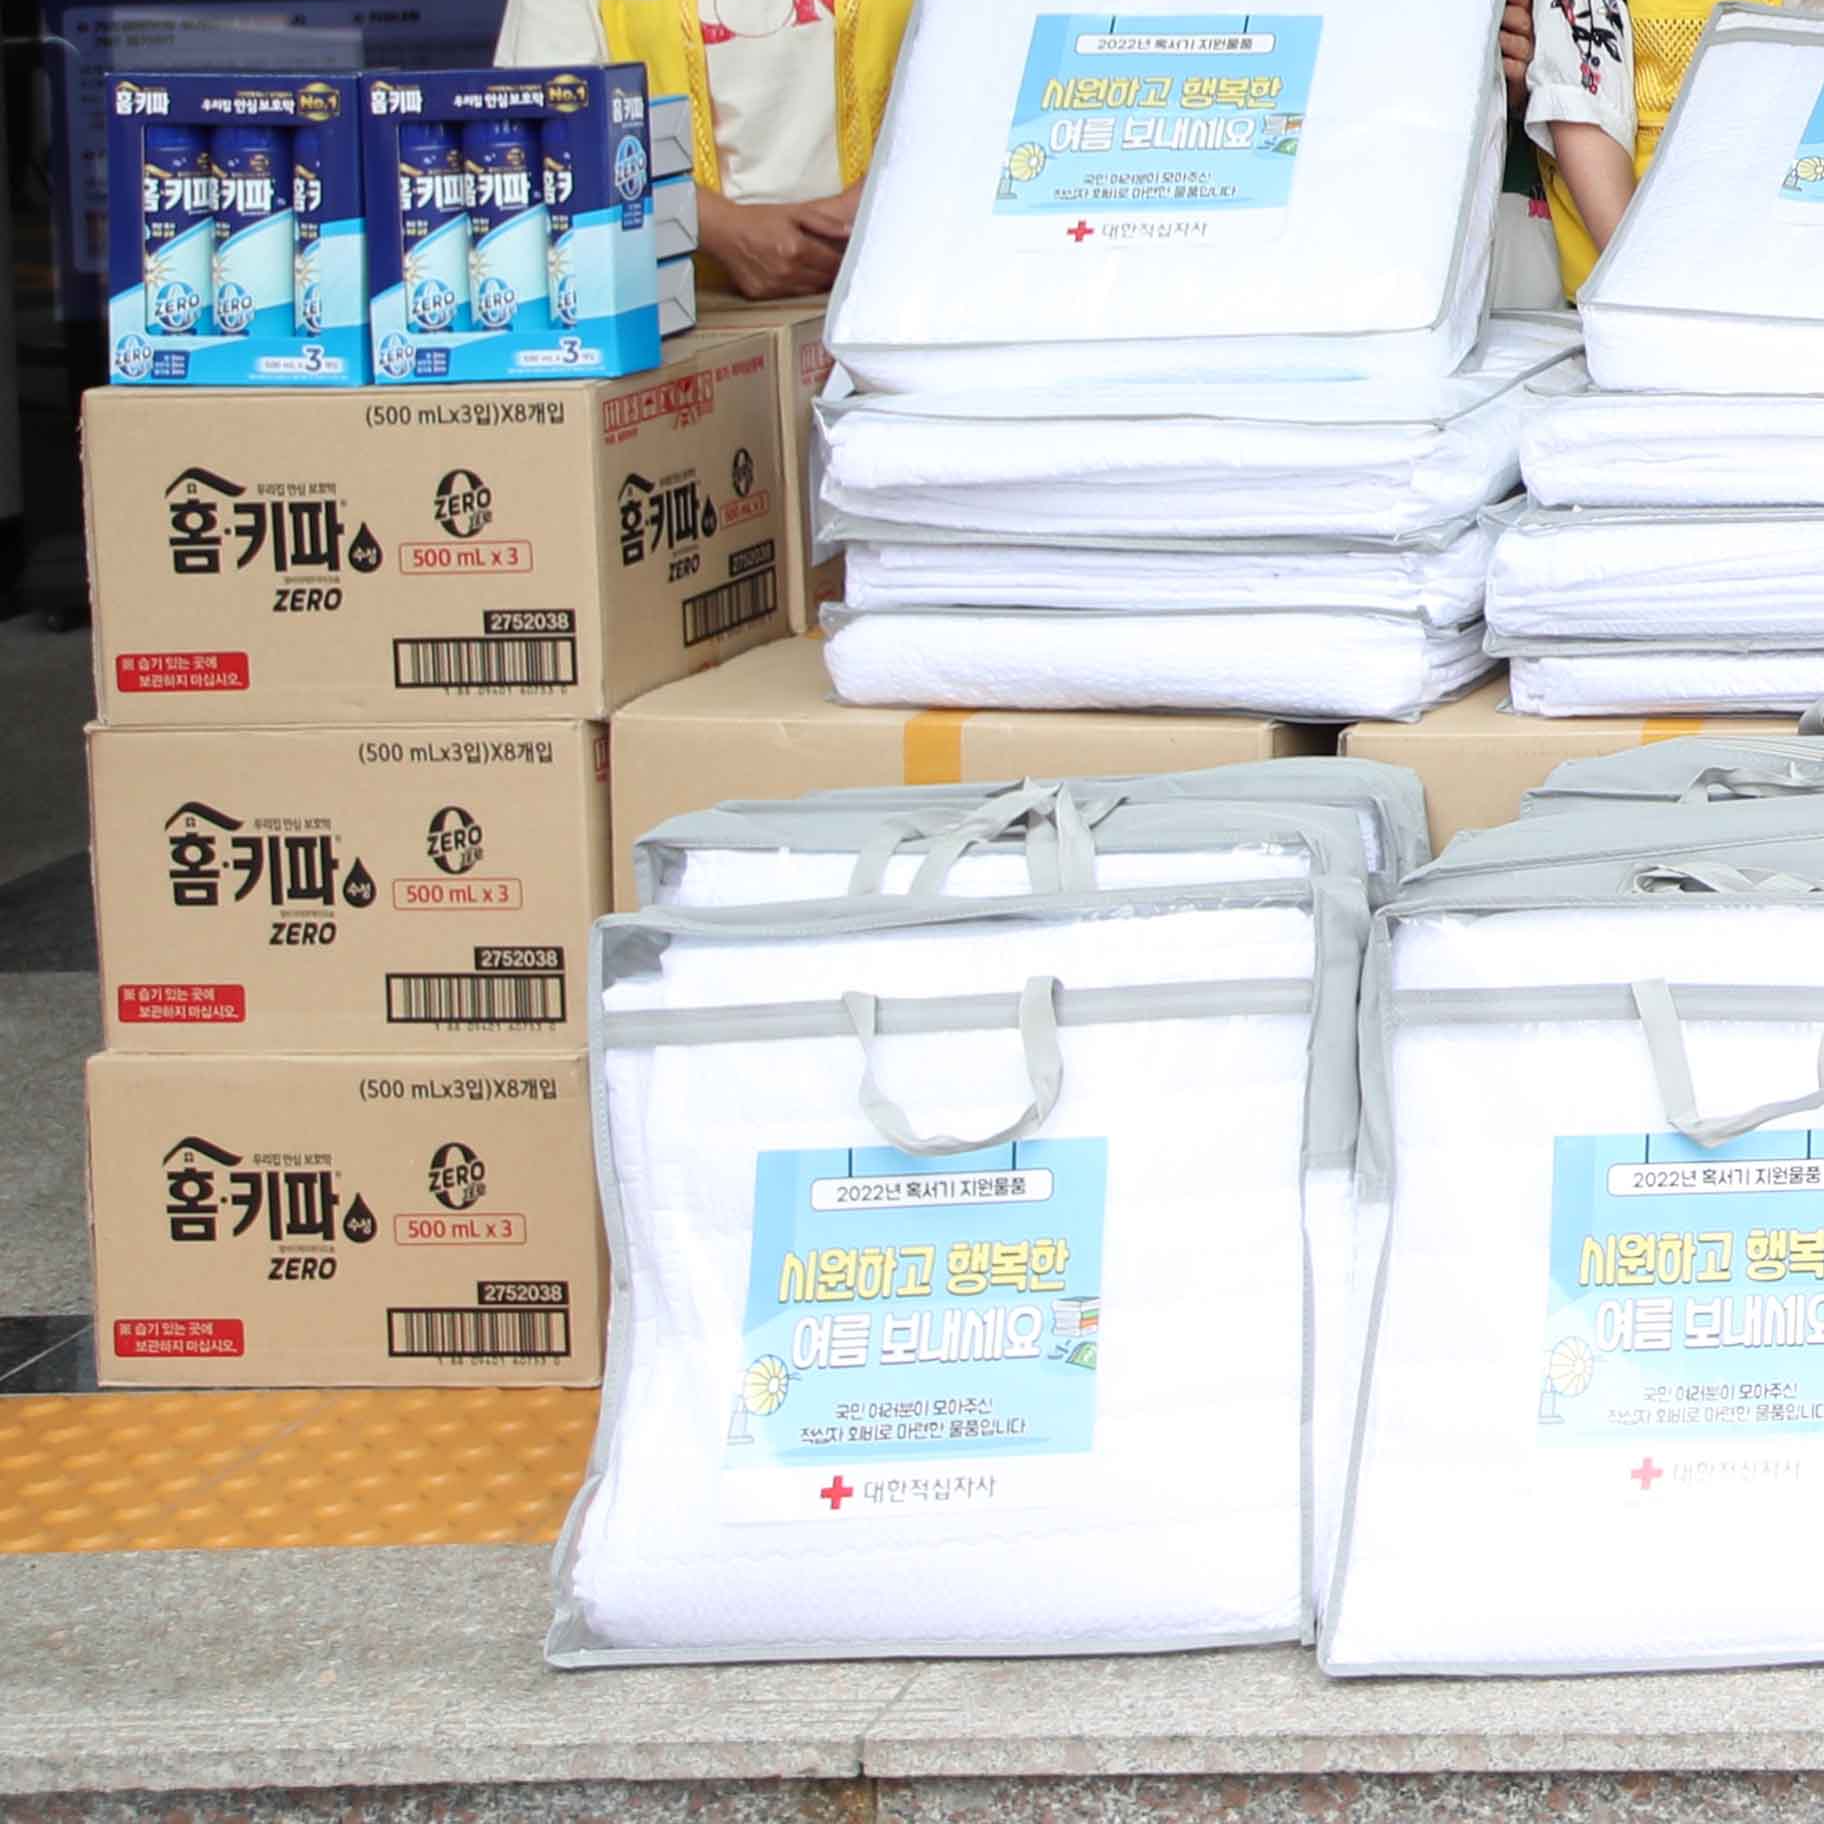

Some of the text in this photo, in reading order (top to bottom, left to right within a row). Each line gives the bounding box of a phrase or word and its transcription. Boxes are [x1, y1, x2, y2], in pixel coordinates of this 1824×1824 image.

[300, 95, 337, 109] No.1
[1040, 76, 1284, 111] 시원하고 행복한
[1049, 116, 1256, 153] 여름 보내세요
[115, 346, 152, 366] ZERO
[304, 346, 322, 372] 3
[366, 401, 565, 428] (500 mLx3입)X8개입
[257, 484, 285, 496] 우리집
[287, 483, 306, 496] 안심
[434, 488, 491, 521] ZERO
[413, 547, 519, 567] 500 mL x 3
[273, 588, 343, 612] ZERO
[491, 613, 570, 630] 2752038
[138, 656, 218, 671] 습기 있는 곳에
[139, 675, 188, 688] 보관하지
[269, 922, 336, 946] ZERO
[481, 950, 558, 968] 2752038
[268, 1257, 337, 1281] ZERO
[1578, 1230, 1734, 1286] 시원하고
[779, 1238, 1070, 1303] 시원하고 행복한
[484, 1285, 563, 1302] 2752038
[791, 1304, 1042, 1370] 여름 보내세요
[1597, 1297, 1674, 1353] 여름
